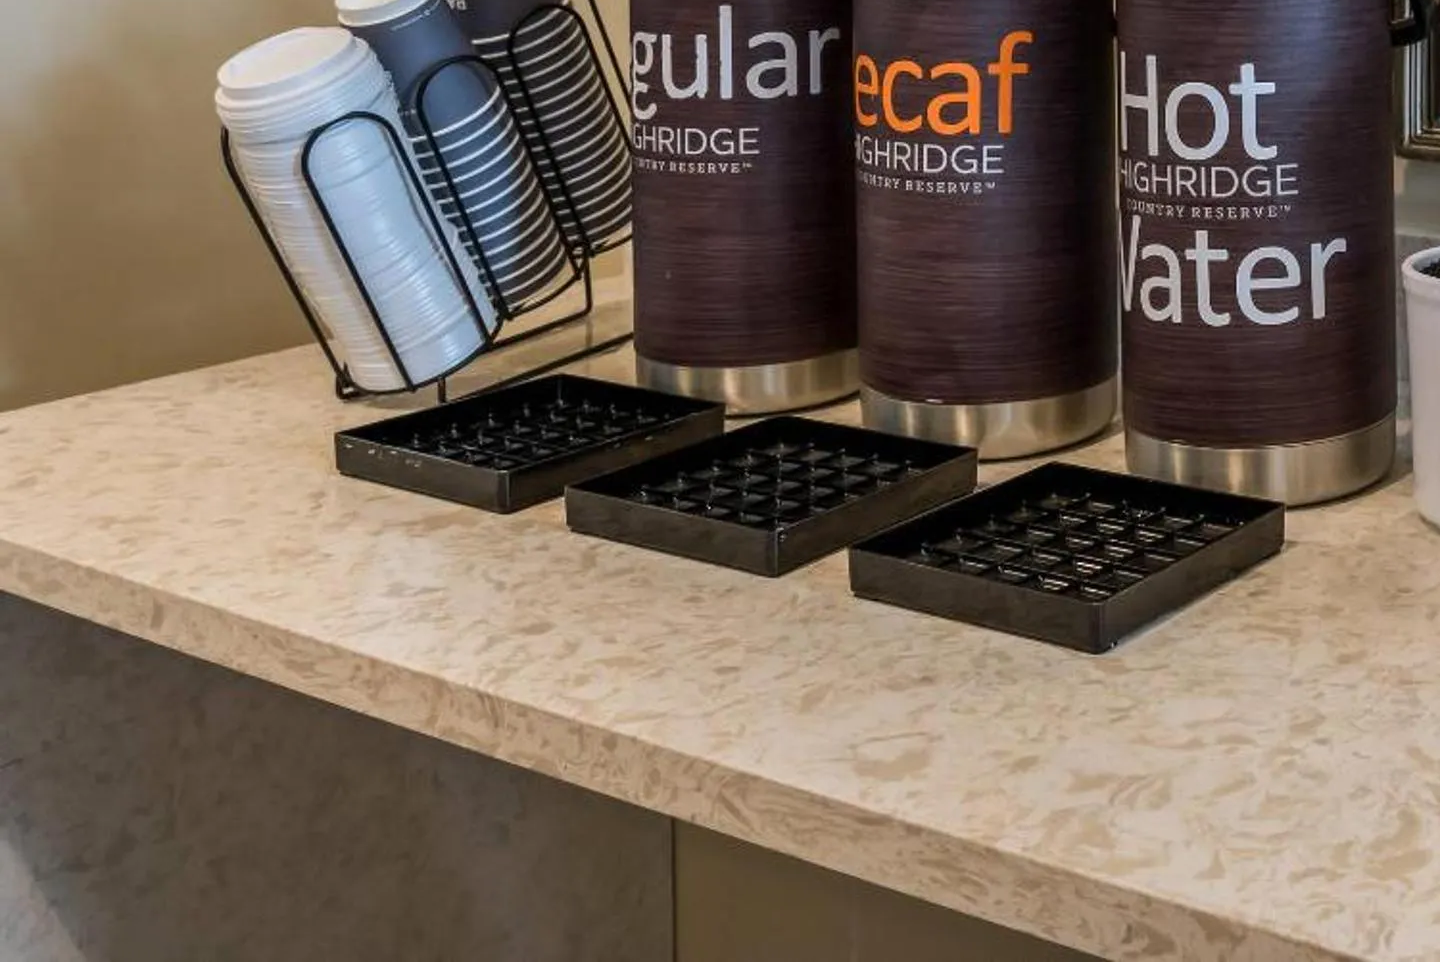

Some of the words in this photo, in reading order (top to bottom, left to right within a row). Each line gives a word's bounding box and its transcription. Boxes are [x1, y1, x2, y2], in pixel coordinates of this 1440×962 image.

[632, 4, 841, 121] gular
[855, 29, 1034, 136] ecaf
[1120, 51, 1278, 161] Hot
